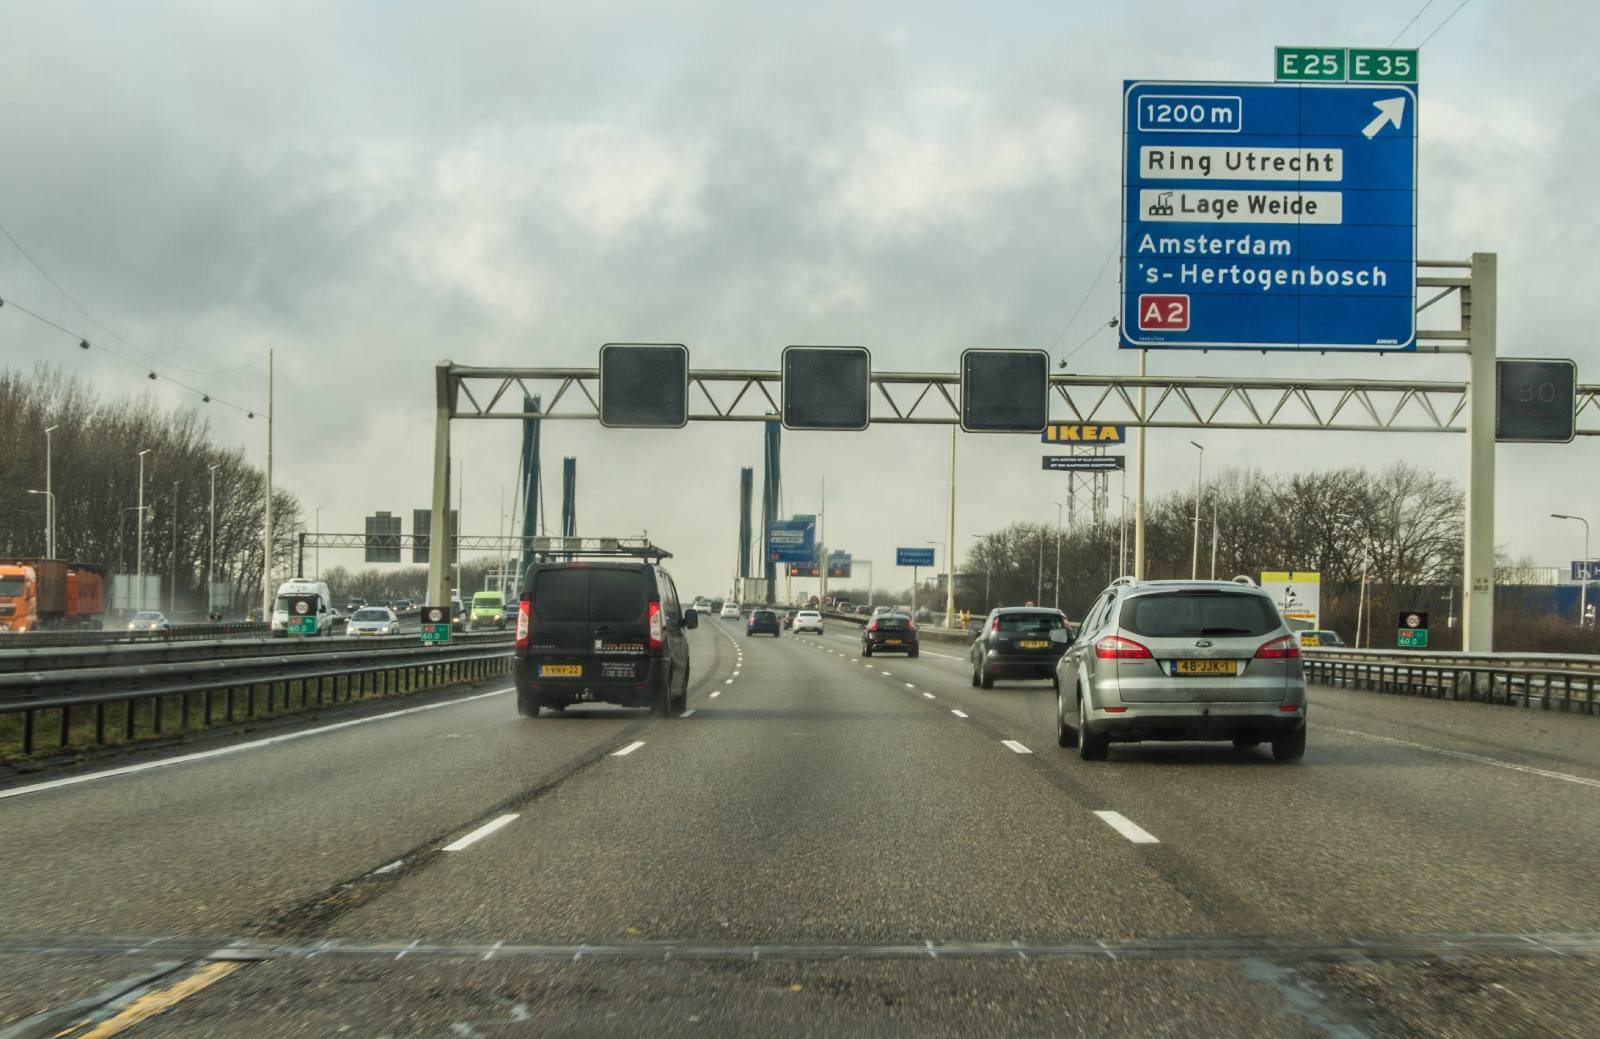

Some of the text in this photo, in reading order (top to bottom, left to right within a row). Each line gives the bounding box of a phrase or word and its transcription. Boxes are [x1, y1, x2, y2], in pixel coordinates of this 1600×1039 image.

[1147, 104, 1233, 123] 1200 m
[1149, 150, 1334, 176] Ring Utrecht
[1181, 194, 1318, 219] Lage Weide
[1138, 233, 1292, 256] Amsterdam
[1047, 425, 1120, 441] IKEA
[1181, 660, 1229, 672] 48-JJK-1
